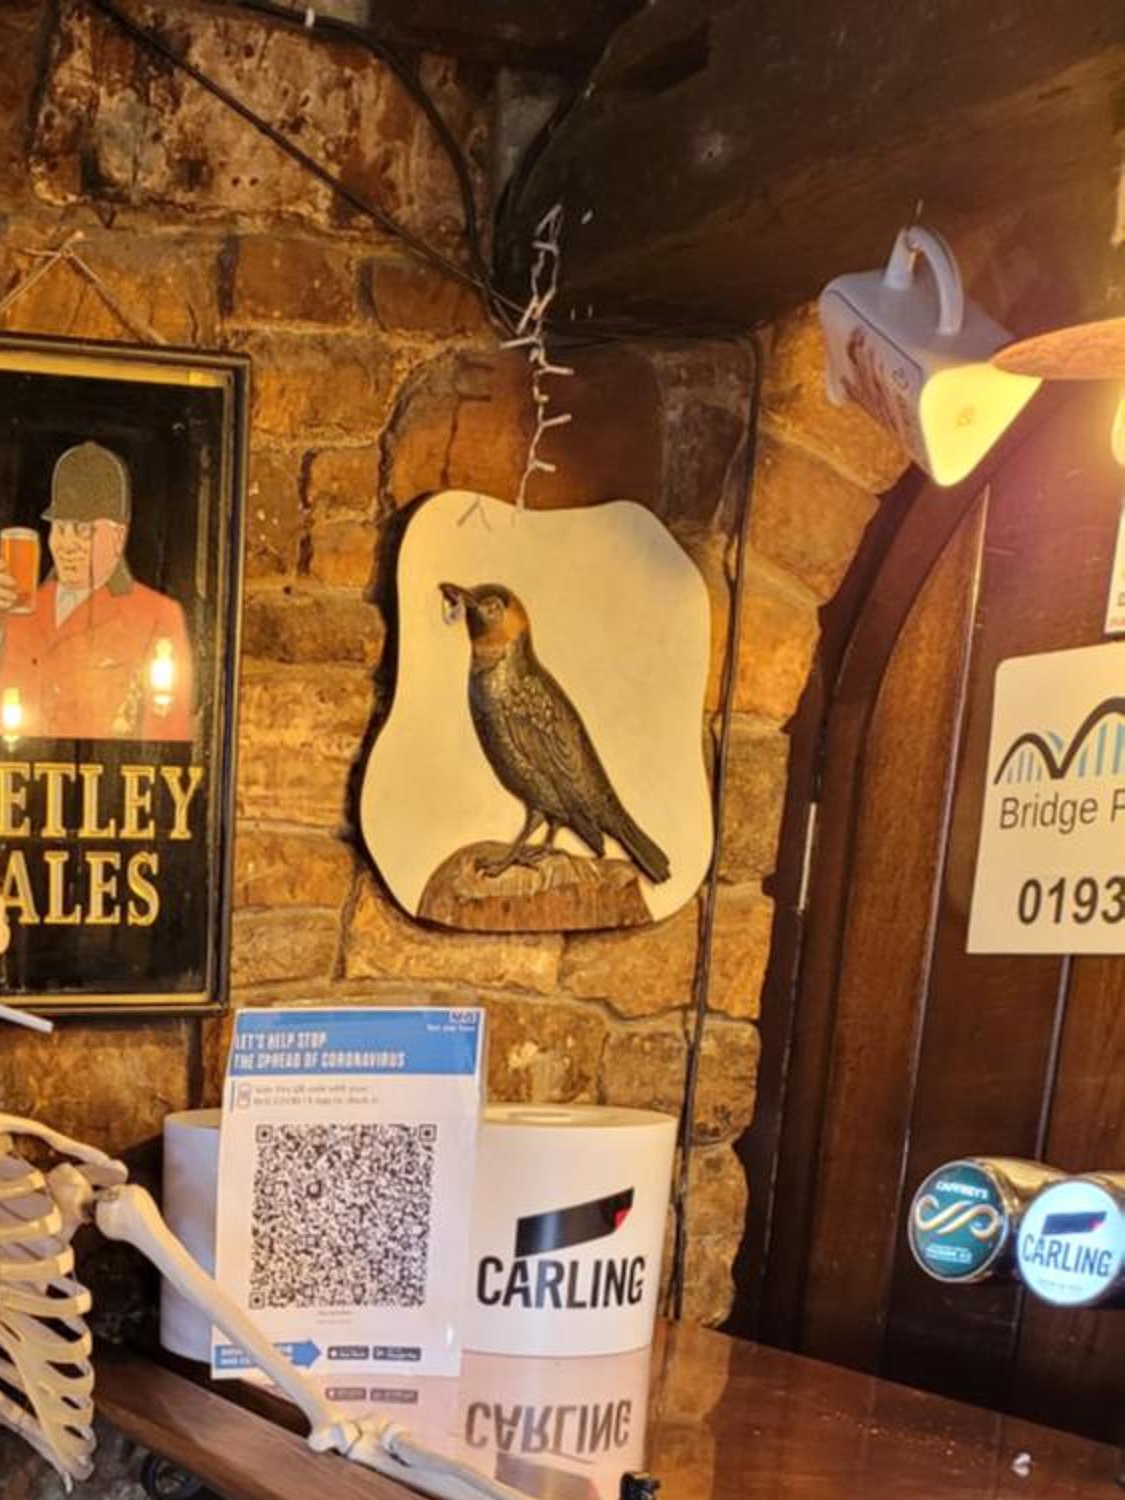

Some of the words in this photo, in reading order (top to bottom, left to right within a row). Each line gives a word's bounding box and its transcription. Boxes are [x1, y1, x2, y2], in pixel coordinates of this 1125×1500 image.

[1000, 791, 1099, 836] Bridge
[1, 850, 160, 926] ALES
[1017, 875, 1125, 926] 0193
[1024, 1233, 1113, 1278] CARLING
[476, 1255, 646, 1310] CARLING
